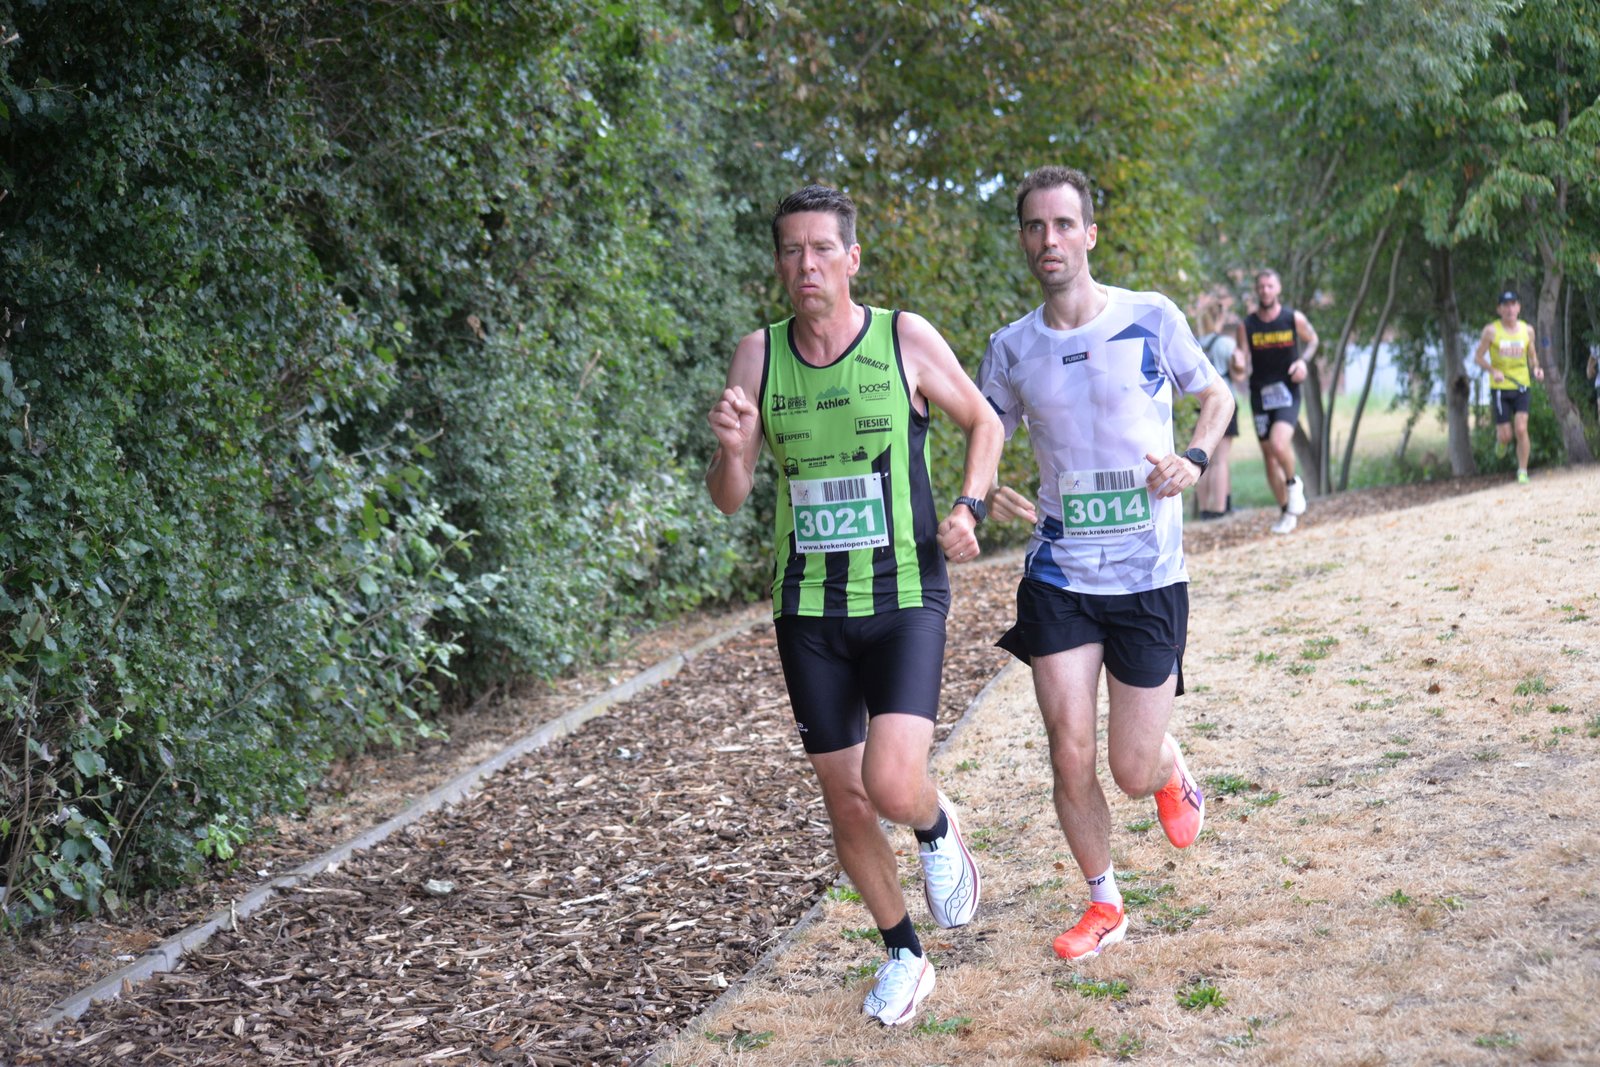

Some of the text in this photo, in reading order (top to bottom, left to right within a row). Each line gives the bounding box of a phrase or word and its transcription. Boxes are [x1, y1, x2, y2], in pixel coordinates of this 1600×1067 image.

[855, 354, 889, 371] BIORACER
[1065, 354, 1086, 363] FUSION
[816, 397, 850, 411] Athlex
[858, 418, 890, 429] FIESIEK
[784, 432, 810, 441] EXPERTS
[1068, 494, 1145, 524] 3014
[799, 505, 875, 537] 3021
[1071, 525, 1146, 536] www.krekenlopers.be
[803, 539, 880, 550] www.krekenlopers.be
